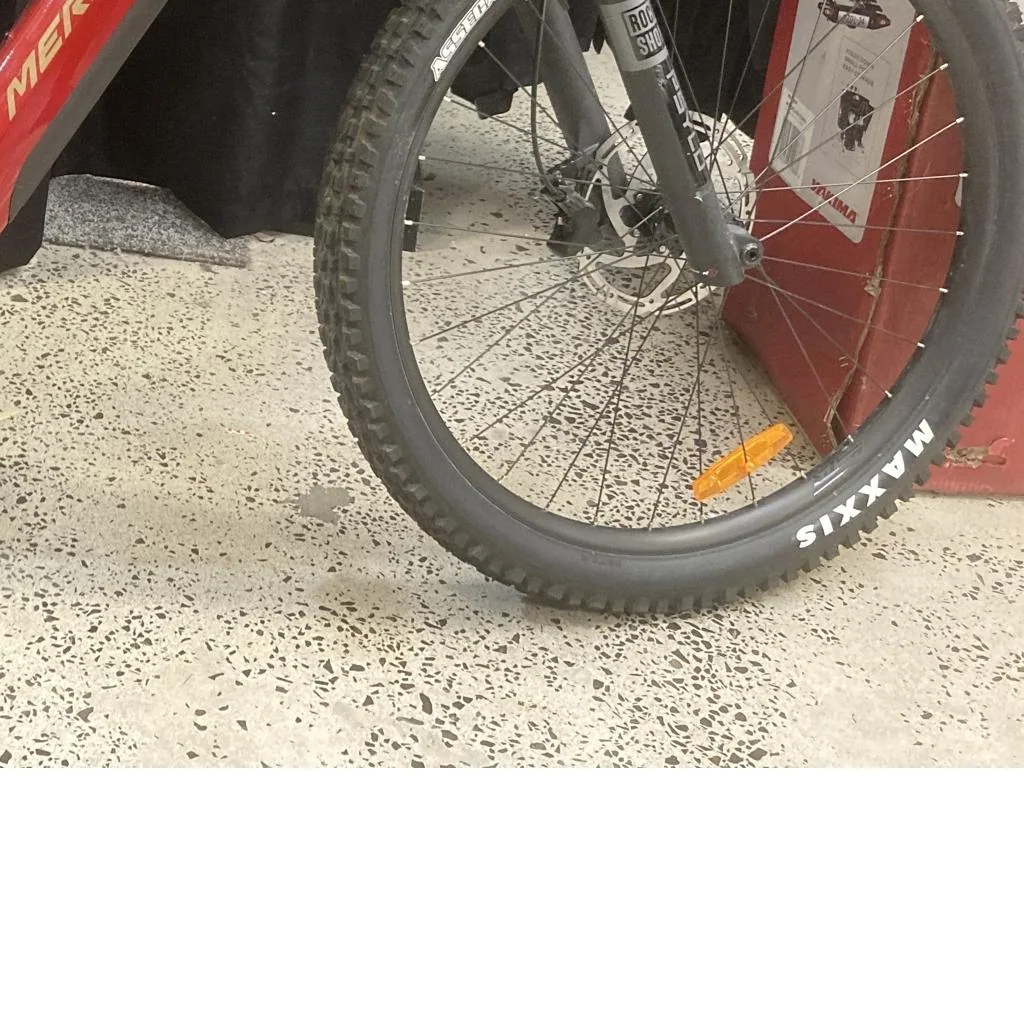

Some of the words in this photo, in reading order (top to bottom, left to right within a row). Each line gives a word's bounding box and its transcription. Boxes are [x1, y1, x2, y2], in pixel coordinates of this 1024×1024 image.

[628, 5, 657, 33] ROC
[636, 29, 663, 56] SHO
[795, 418, 935, 549] MAXXIS
